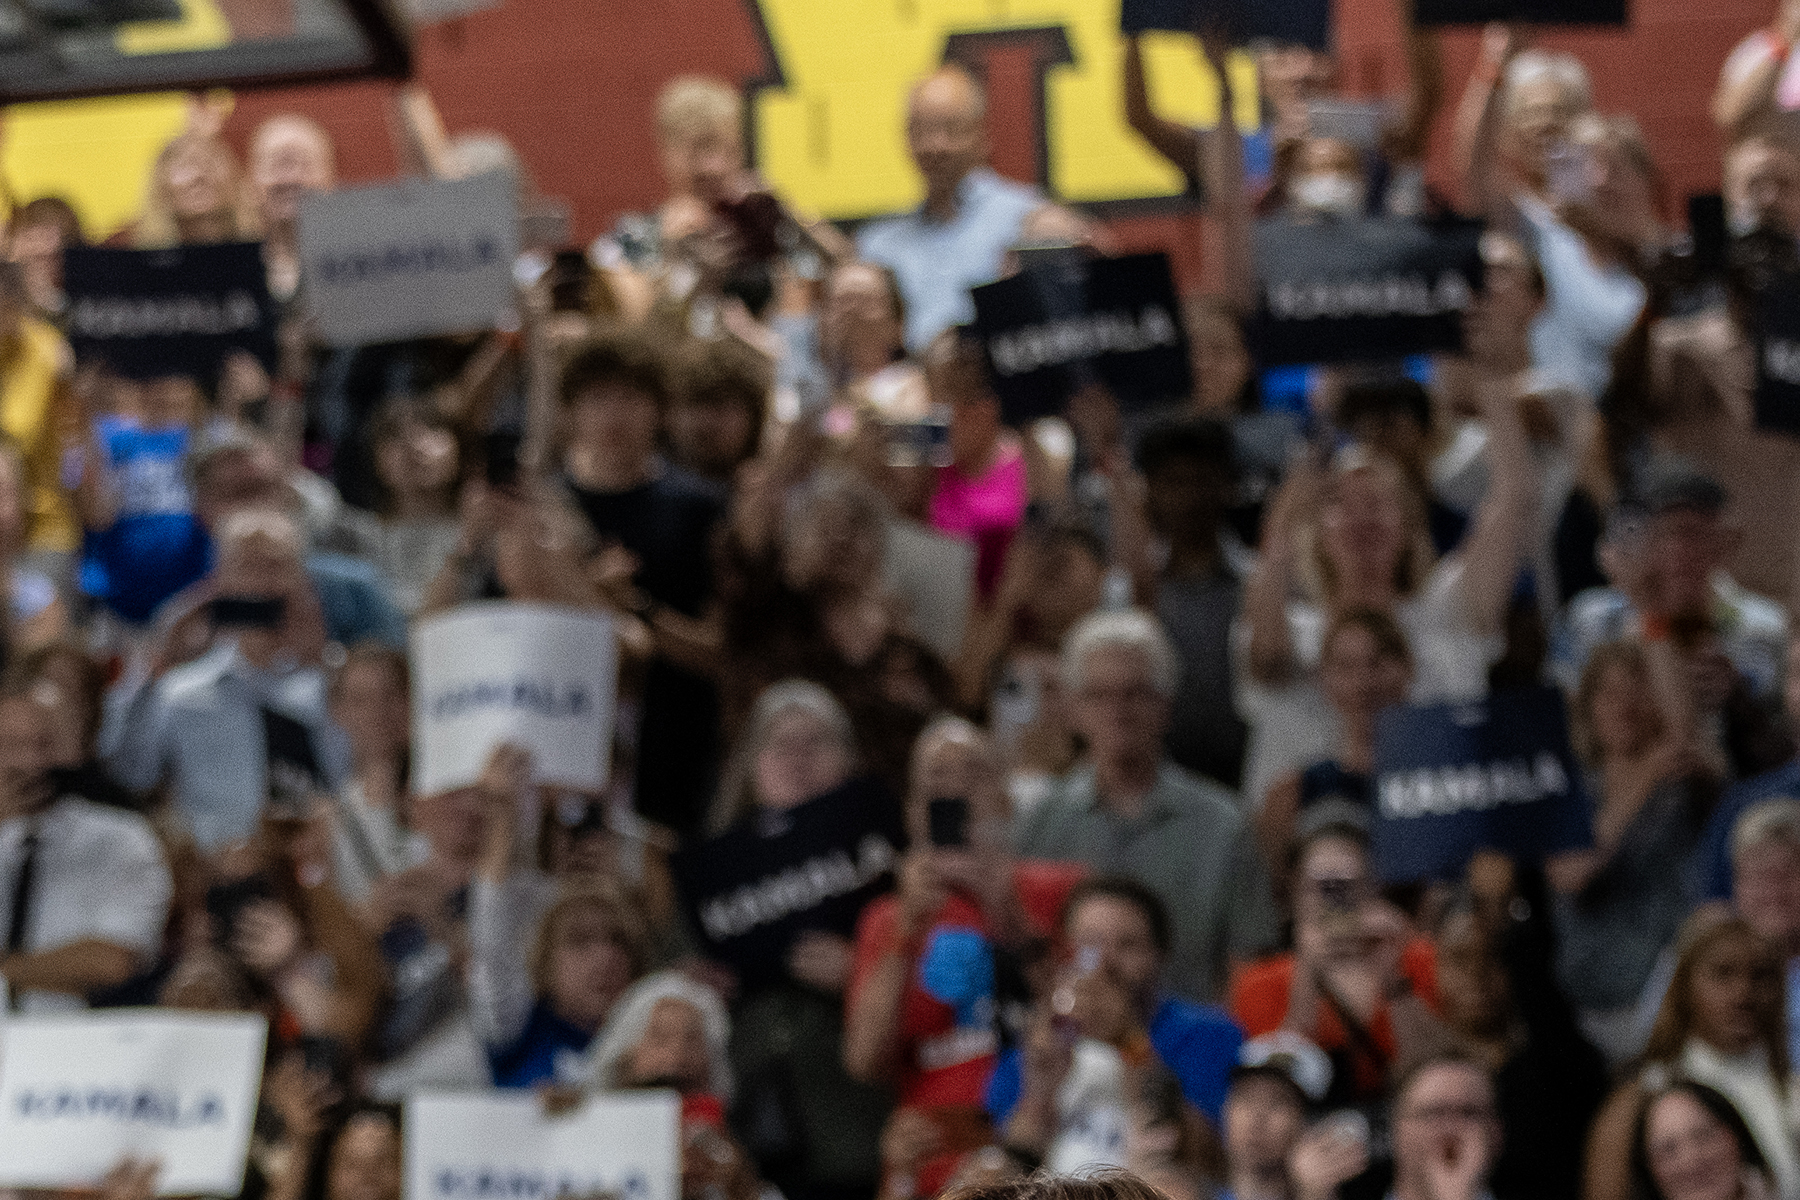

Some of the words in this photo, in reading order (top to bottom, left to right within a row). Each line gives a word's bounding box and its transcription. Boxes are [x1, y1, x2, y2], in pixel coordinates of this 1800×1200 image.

[317, 236, 499, 286] KAMALA
[70, 296, 258, 338] KAMALA
[1266, 272, 1474, 319] KAMALA
[988, 305, 1176, 377] KAMALA
[1376, 749, 1569, 822] KAMALA
[699, 835, 895, 939] KAMALA
[14, 1087, 225, 1124] KAMALA
